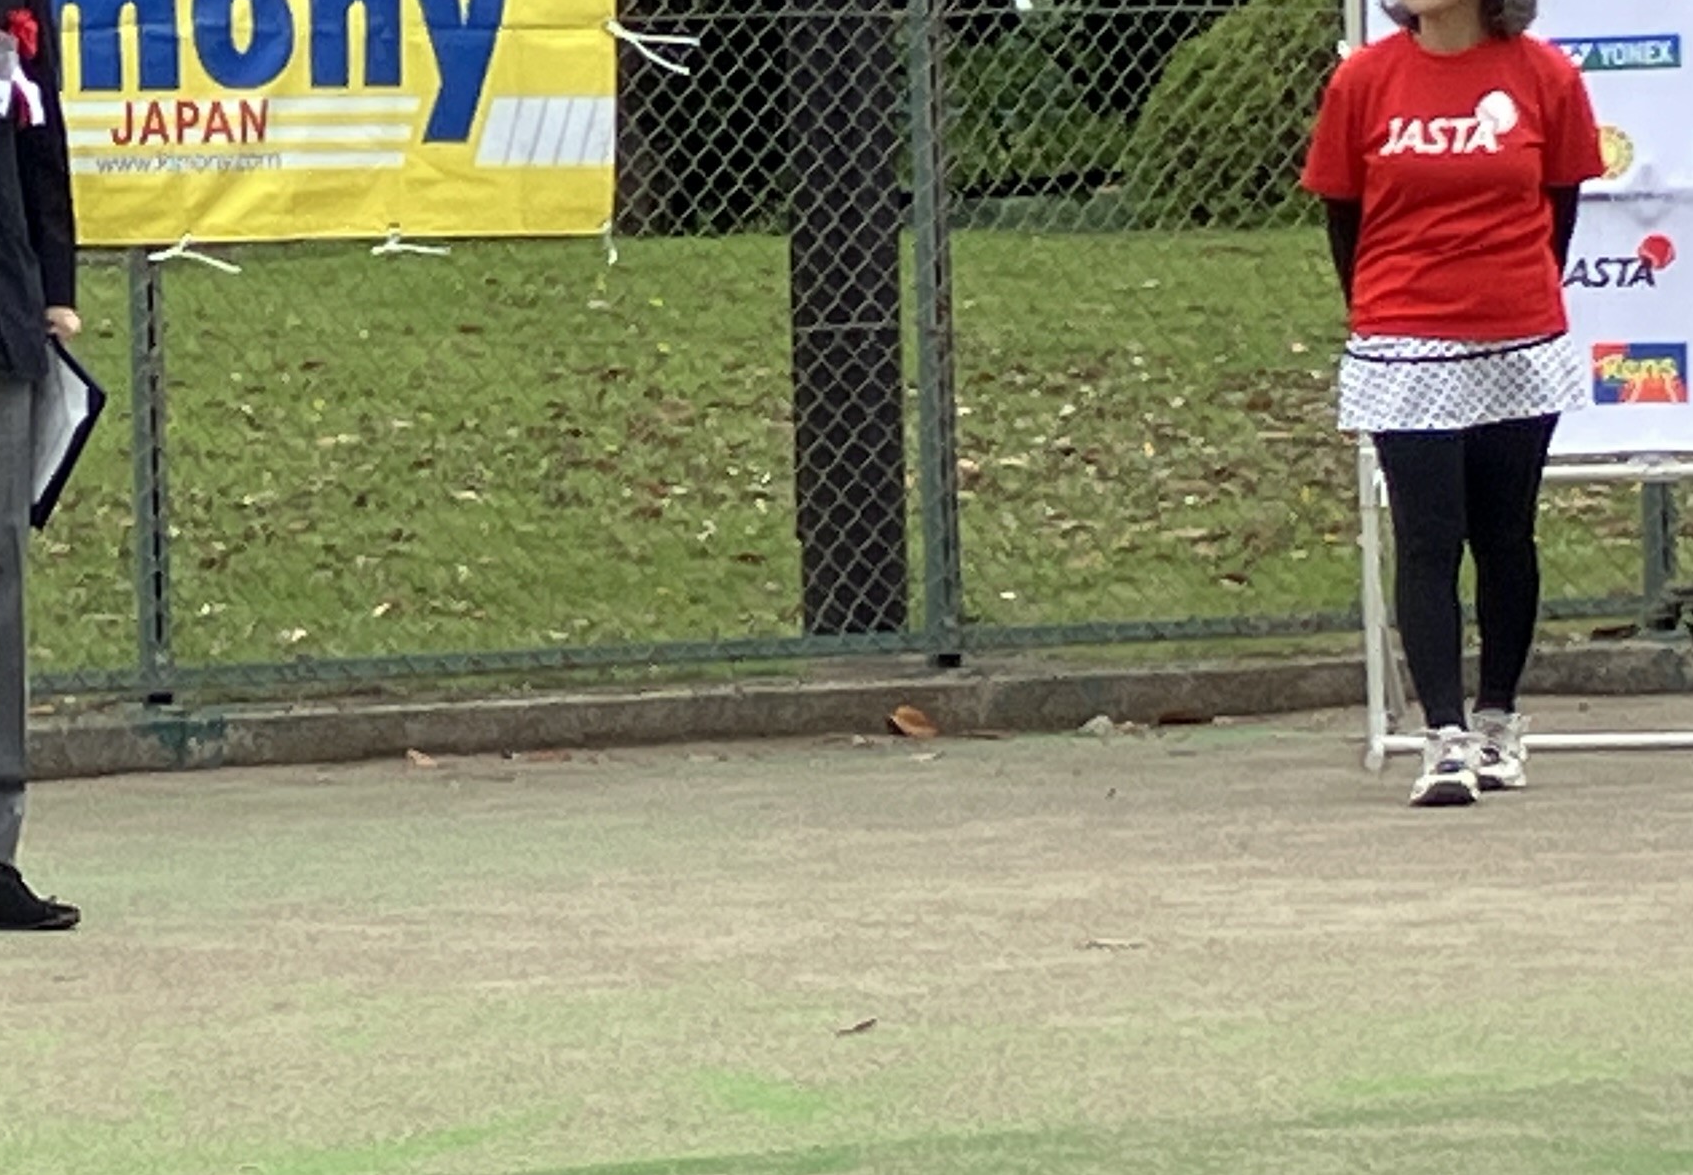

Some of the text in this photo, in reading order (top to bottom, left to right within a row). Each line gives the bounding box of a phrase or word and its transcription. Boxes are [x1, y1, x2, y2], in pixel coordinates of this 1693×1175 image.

[110, 98, 269, 145] JAPAN
[1379, 117, 1499, 156] JASTA
[1562, 257, 1655, 288] ASTA
